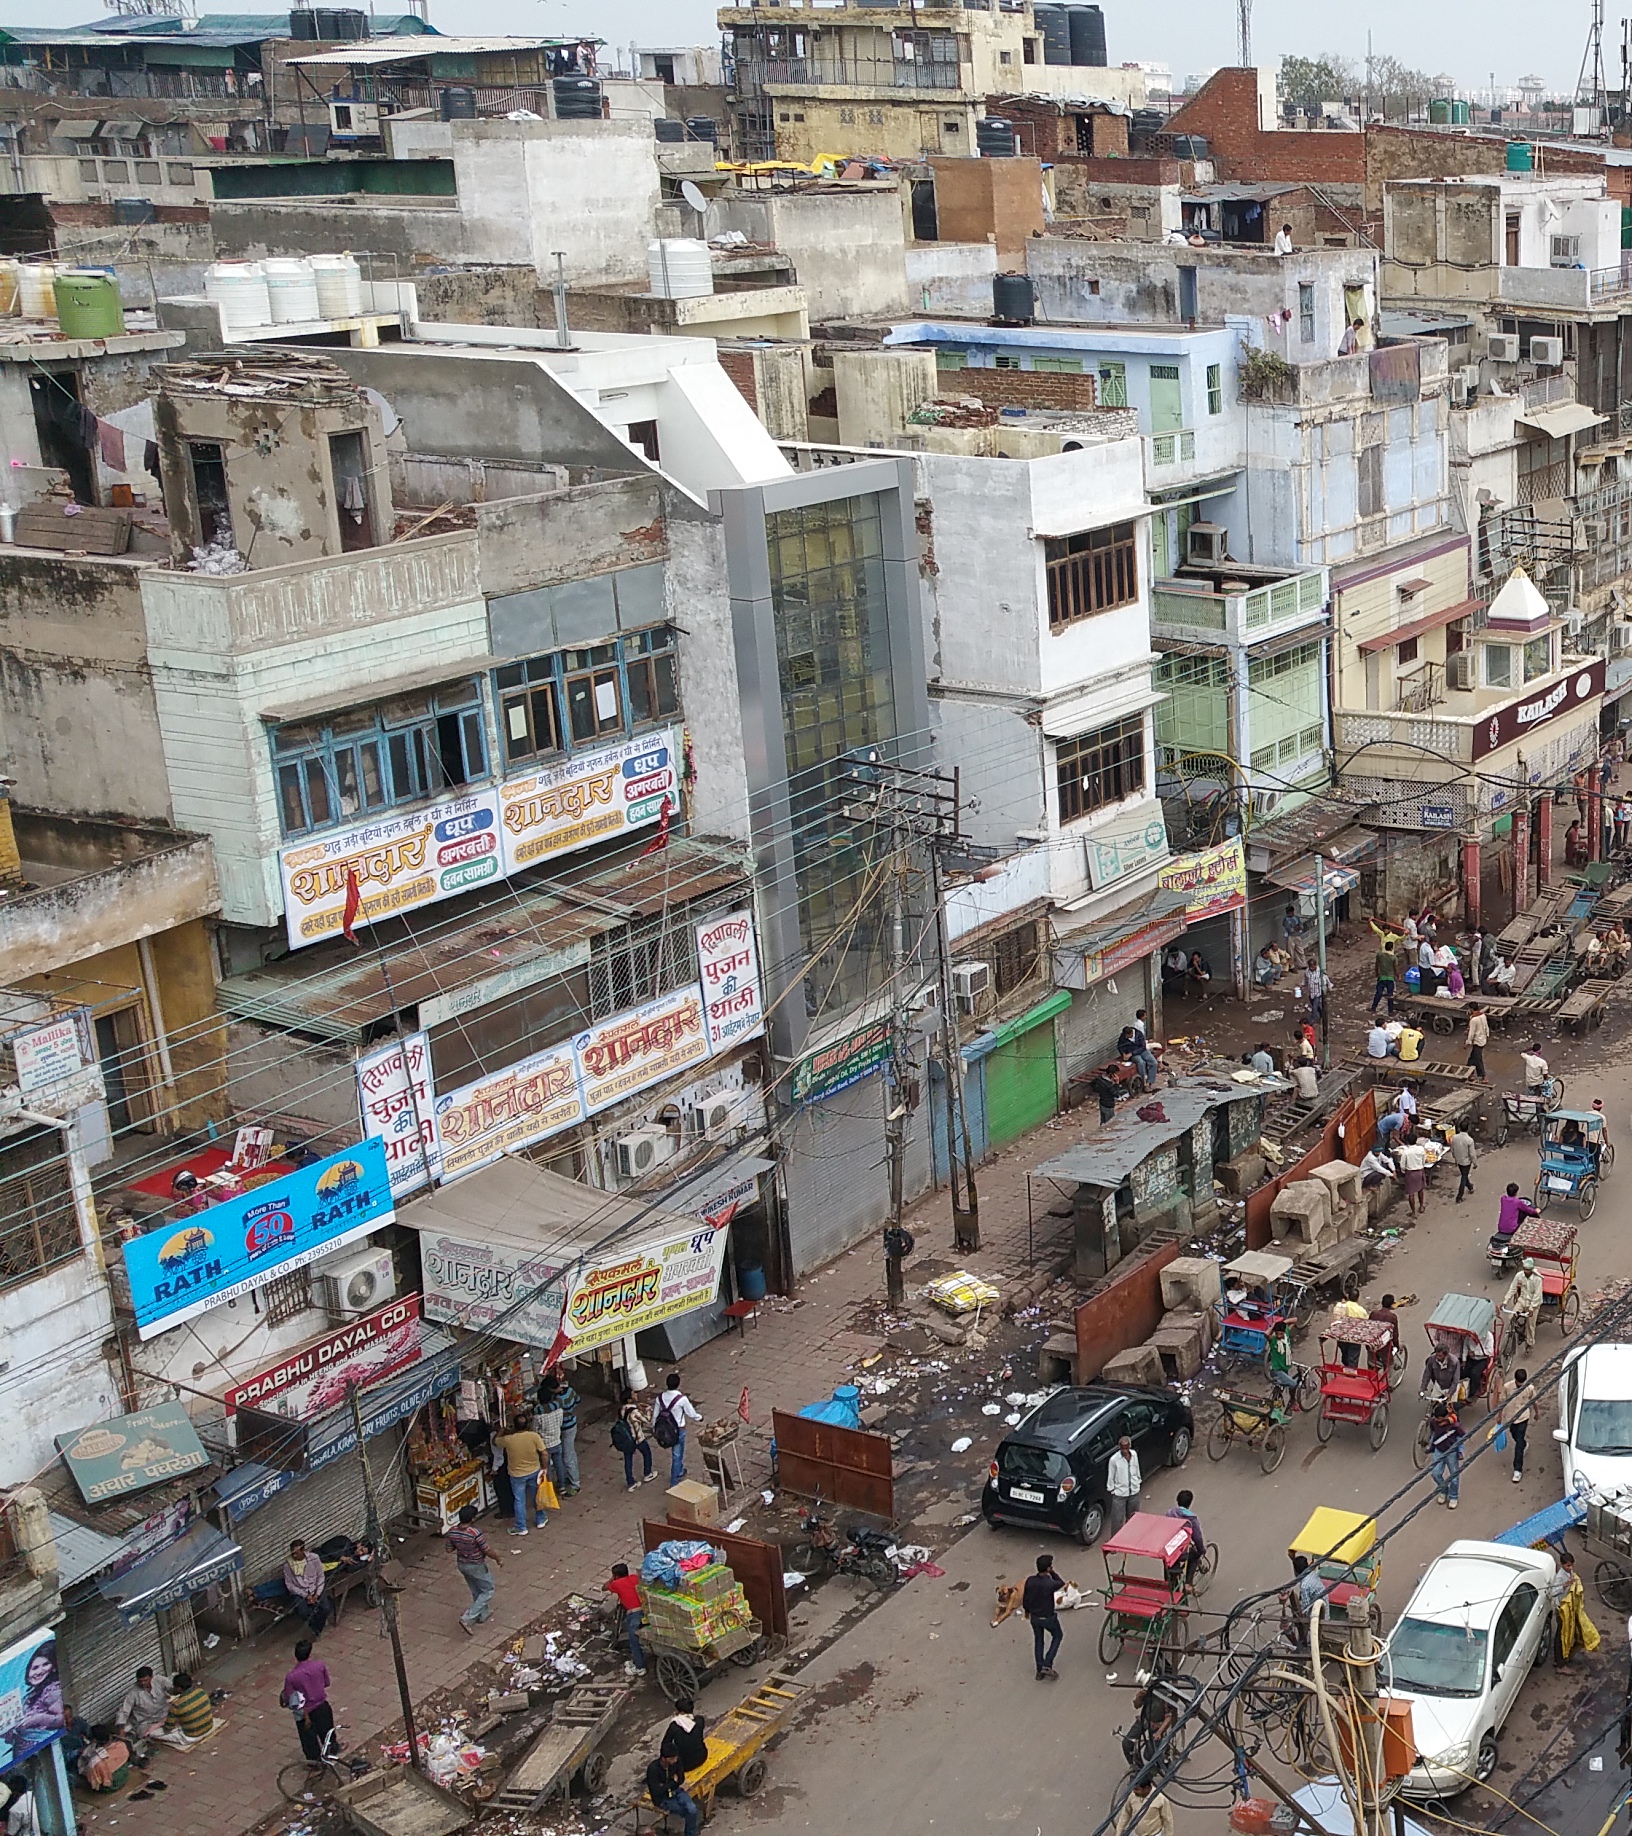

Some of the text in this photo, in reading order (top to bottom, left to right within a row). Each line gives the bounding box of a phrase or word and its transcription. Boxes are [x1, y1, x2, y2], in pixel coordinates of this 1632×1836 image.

[1517, 679, 1568, 724] KAILASH
[634, 753, 660, 774] धूप
[505, 774, 613, 832] शानदार
[445, 815, 474, 837] धूप
[440, 836, 492, 865] अगरबत्ती
[294, 838, 427, 901] शानदार
[443, 870, 463, 888] हवन
[1161, 862, 1204, 890] बालाजी
[722, 975, 737, 996] की
[710, 987, 755, 1021] थाली
[32, 1028, 72, 1048] Mallika
[53, 1041, 59, 1049] 5
[585, 1003, 699, 1078] शानदार
[711, 1023, 721, 1043] 31
[442, 1065, 572, 1143] शानदार
[393, 1110, 414, 1134] की
[728, 1182, 753, 1202] KUMAR
[247, 1199, 286, 1220] More Than
[311, 1190, 371, 1231] RATH
[253, 1214, 284, 1245] 50
[690, 1230, 716, 1254] धूप
[154, 1259, 222, 1303] RATH
[204, 1283, 240, 1310] PRABHU
[240, 1273, 269, 1293] DAYAL
[270, 1268, 277, 1278] &
[277, 1262, 292, 1276] CO.
[295, 1252, 307, 1269] Ph:
[307, 1237, 342, 1263] 23955210
[428, 1253, 513, 1299] शानदार
[572, 1268, 661, 1325] शानदार
[235, 1358, 314, 1407] PRABHU
[318, 1322, 377, 1364] DAYAL
[381, 1305, 411, 1330] CO.
[258, 1382, 301, 1408] Specialised
[309, 1362, 335, 1382] HEENG
[335, 1356, 349, 1369] and
[349, 1346, 363, 1360] TEA
[364, 1331, 393, 1351] MASALA
[89, 1452, 203, 1498] अचार पचरंगा
[186, 1559, 236, 1590] पचरंगा
